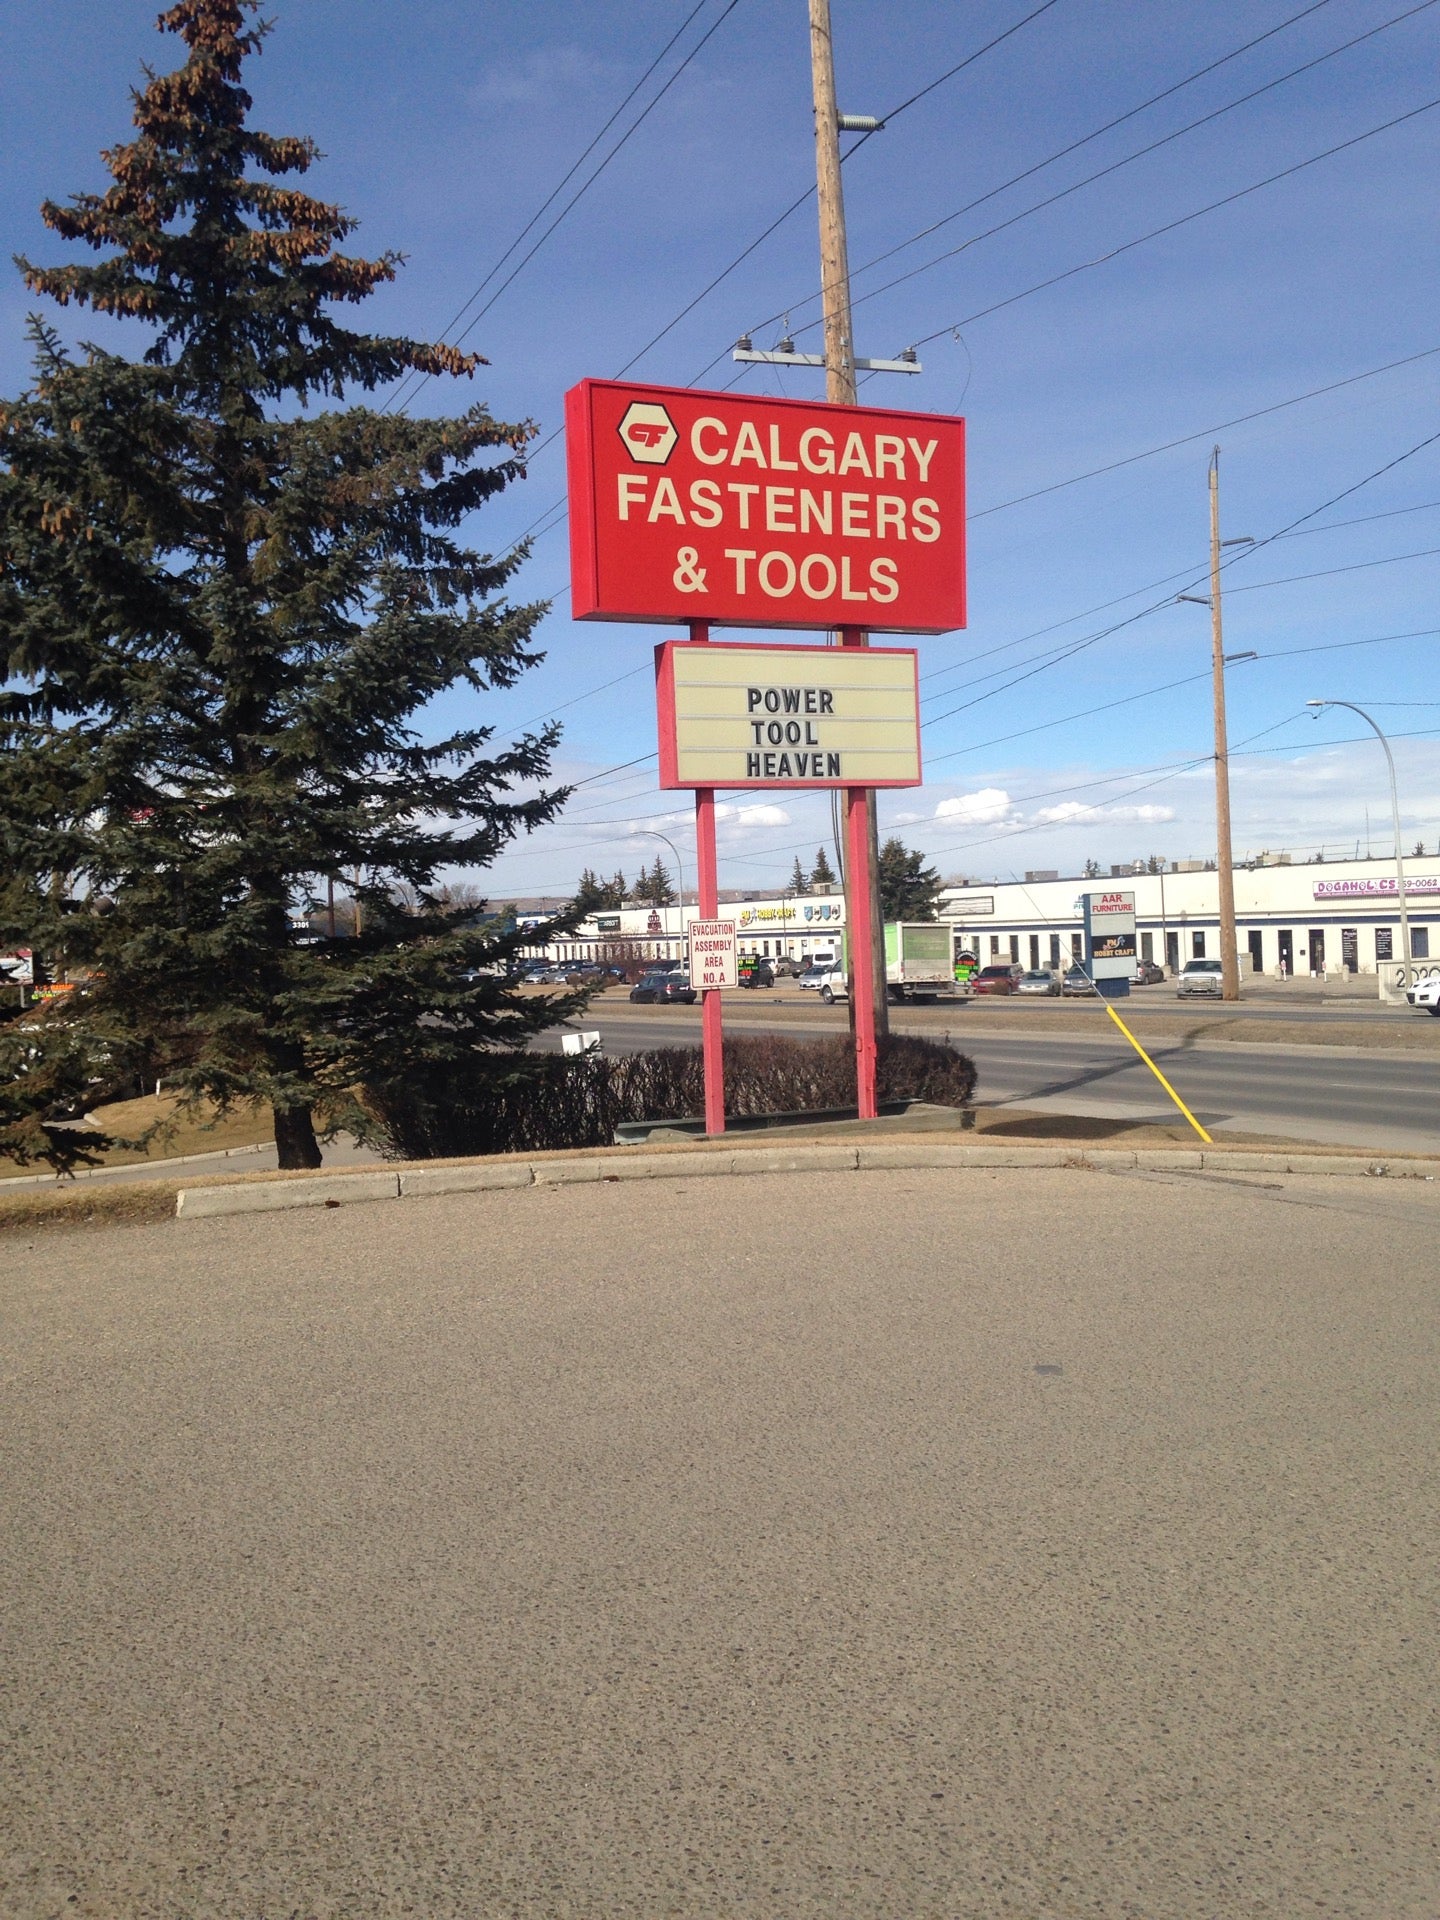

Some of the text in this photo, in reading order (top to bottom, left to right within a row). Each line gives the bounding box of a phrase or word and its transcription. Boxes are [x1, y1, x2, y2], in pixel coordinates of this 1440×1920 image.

[690, 416, 939, 483] CALGARY
[616, 473, 941, 543] FASTENERS
[672, 545, 899, 604] & TOOLS
[747, 688, 834, 714] POWER
[750, 720, 818, 746] TOOL
[746, 752, 840, 778] HEAVEN
[1398, 879, 1438, 888] 59-0062
[1101, 894, 1122, 903] AAR
[1092, 903, 1133, 913] FURNITURE
[692, 923, 733, 936] EVACUATION
[694, 940, 732, 952] ASSEMBLY
[704, 956, 724, 968] AREA
[703, 972, 717, 984] NO.
[719, 972, 726, 983] A
